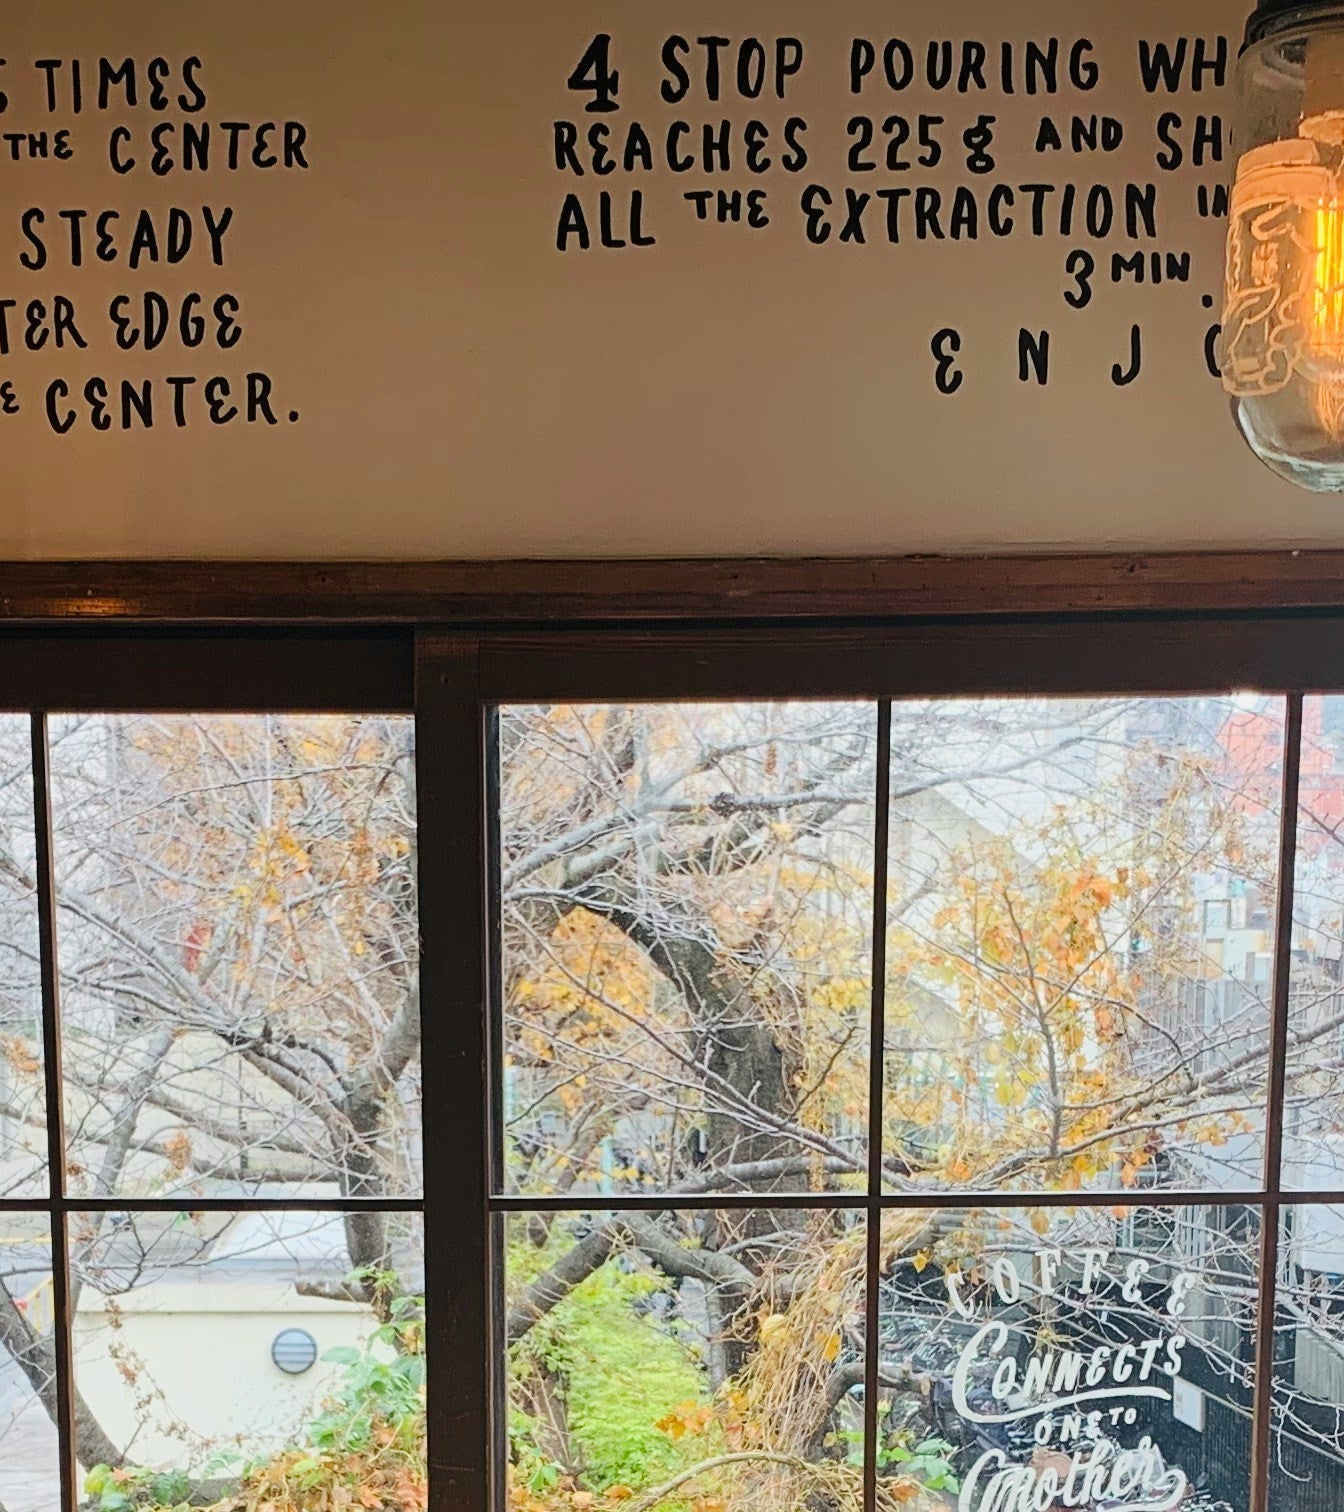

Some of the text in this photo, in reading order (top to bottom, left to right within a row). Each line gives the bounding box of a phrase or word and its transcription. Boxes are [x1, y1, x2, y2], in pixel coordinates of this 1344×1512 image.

[35, 56, 206, 113] TIMES
[568, 34, 619, 113] 4
[661, 35, 802, 103] STOP
[851, 38, 1098, 95] POURING
[1139, 36, 1227, 93] WH
[3, 130, 73, 160] THE
[110, 122, 308, 176] CENTER
[554, 117, 807, 176] REACHES
[1036, 115, 1123, 152] AND
[20, 206, 233, 270] STEADY
[557, 190, 655, 251] ALL
[684, 190, 769, 228] THE
[801, 184, 1156, 244] EXTRACTION
[1064, 250, 1094, 308] 3
[110, 292, 241, 350] EDGE
[46, 373, 298, 433] CENTER.
[944, 1248, 1197, 1320] COFFEE
[1033, 1405, 1138, 1446] ONE TO
